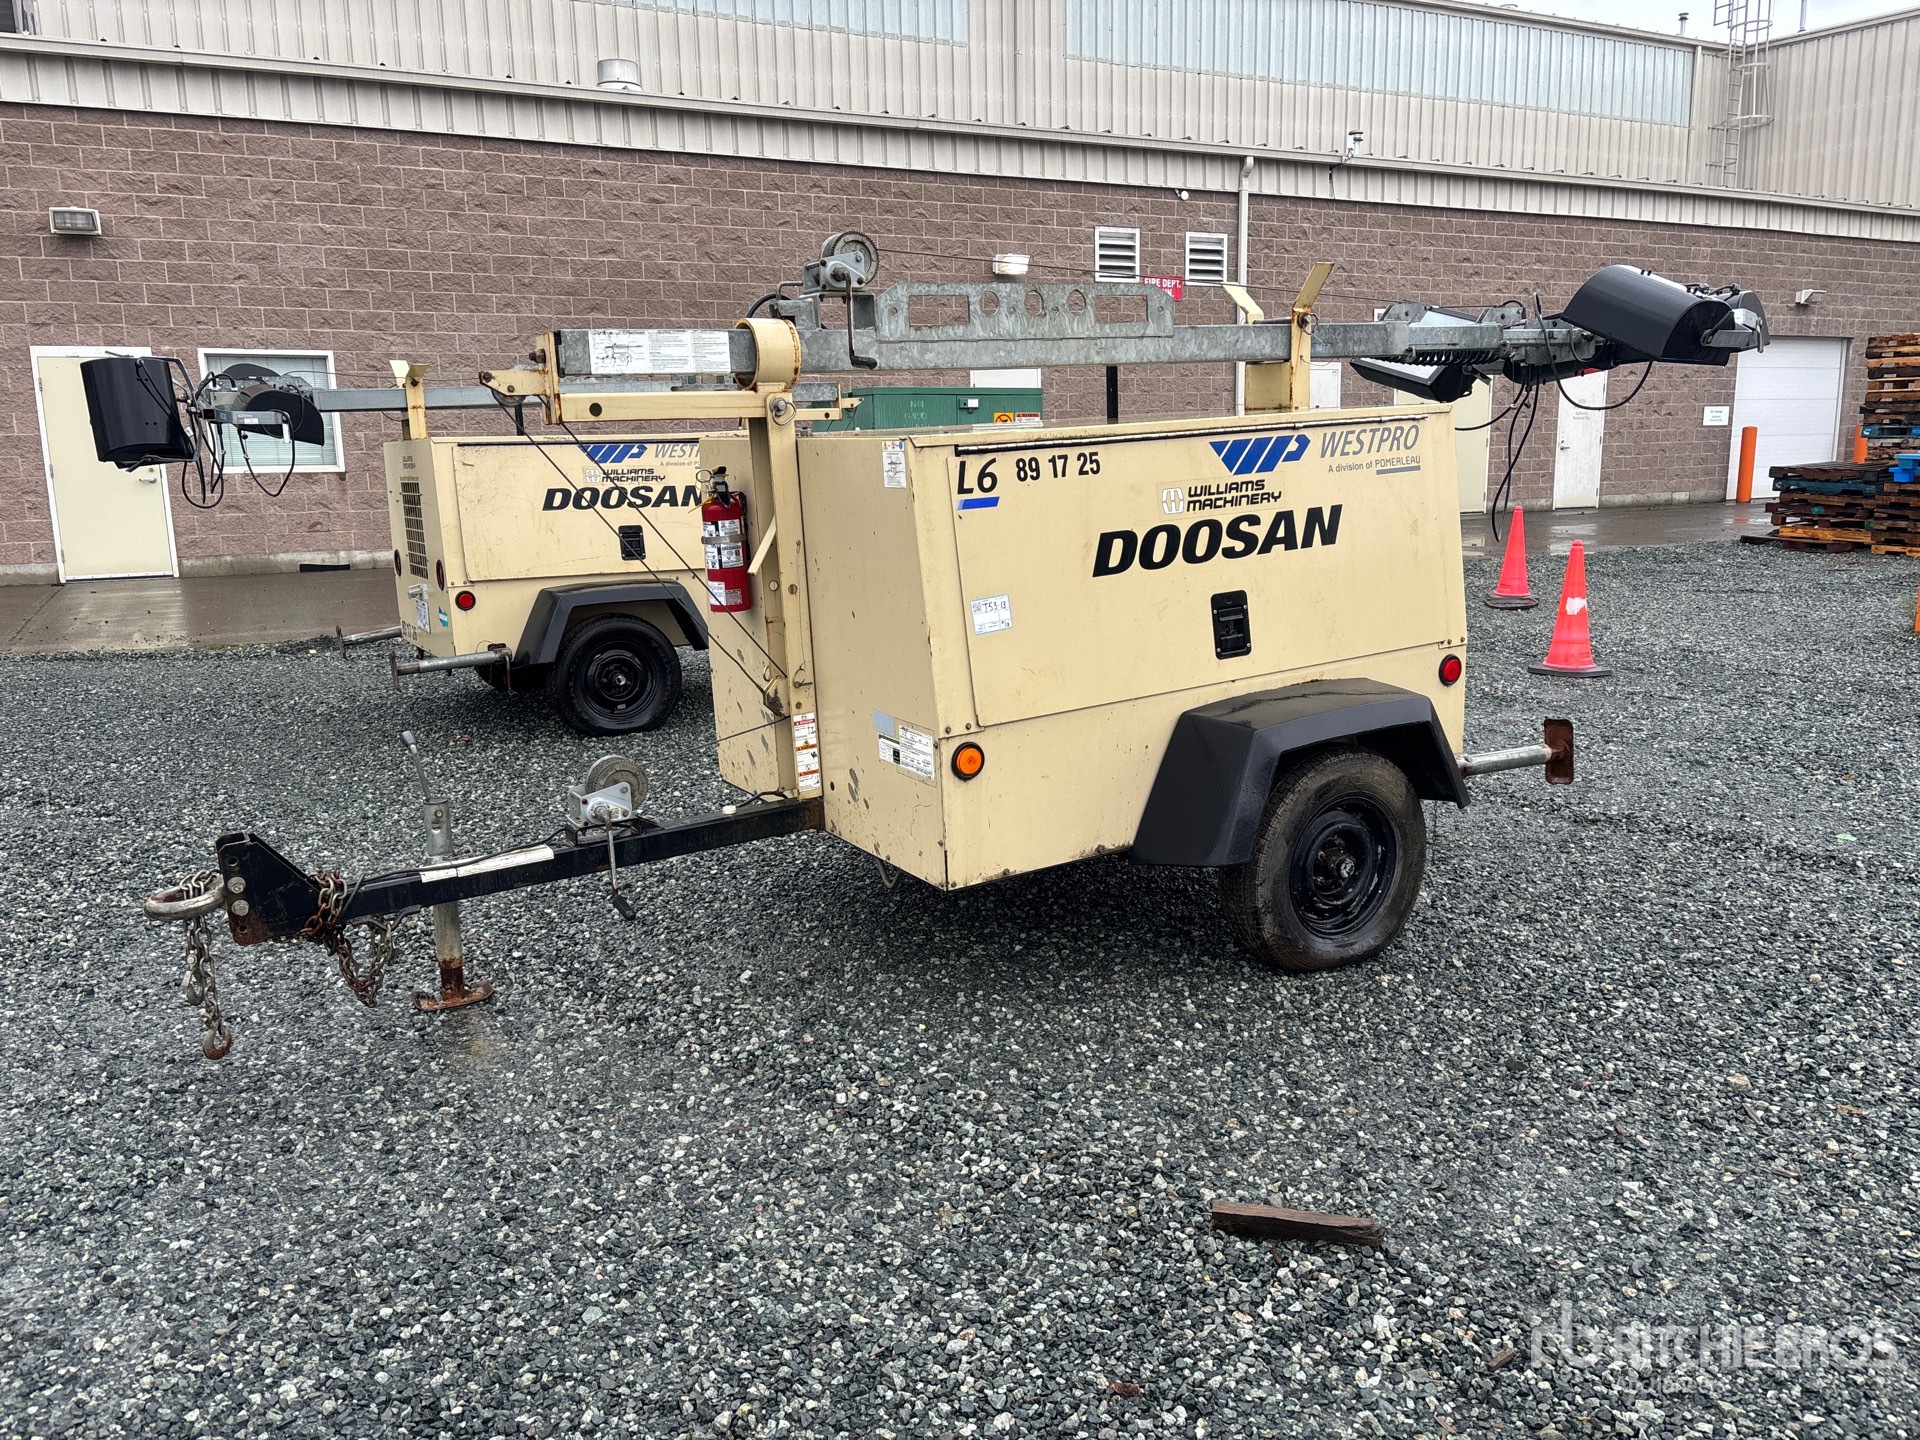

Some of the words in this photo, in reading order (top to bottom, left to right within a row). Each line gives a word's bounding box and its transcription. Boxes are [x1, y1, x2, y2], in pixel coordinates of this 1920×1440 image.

[1144, 278, 1161, 287] FIRE
[1162, 279, 1181, 288] DEPT.
[1320, 424, 1420, 459] WESTPRO
[957, 457, 998, 495] L6
[1015, 456, 1041, 482] 89
[1048, 454, 1069, 479] 17
[1077, 451, 1101, 476] 25
[1328, 462, 1334, 473] A
[1335, 460, 1364, 473] division
[1365, 460, 1374, 471] of
[1374, 454, 1421, 468] POMERLEAU
[601, 474, 666, 483] MACHINERY
[1187, 479, 1265, 498] WILLIAMS
[542, 485, 702, 511] DOOSAN
[1186, 490, 1282, 512] MACHINERY
[1092, 503, 1343, 577] DOOSAN
